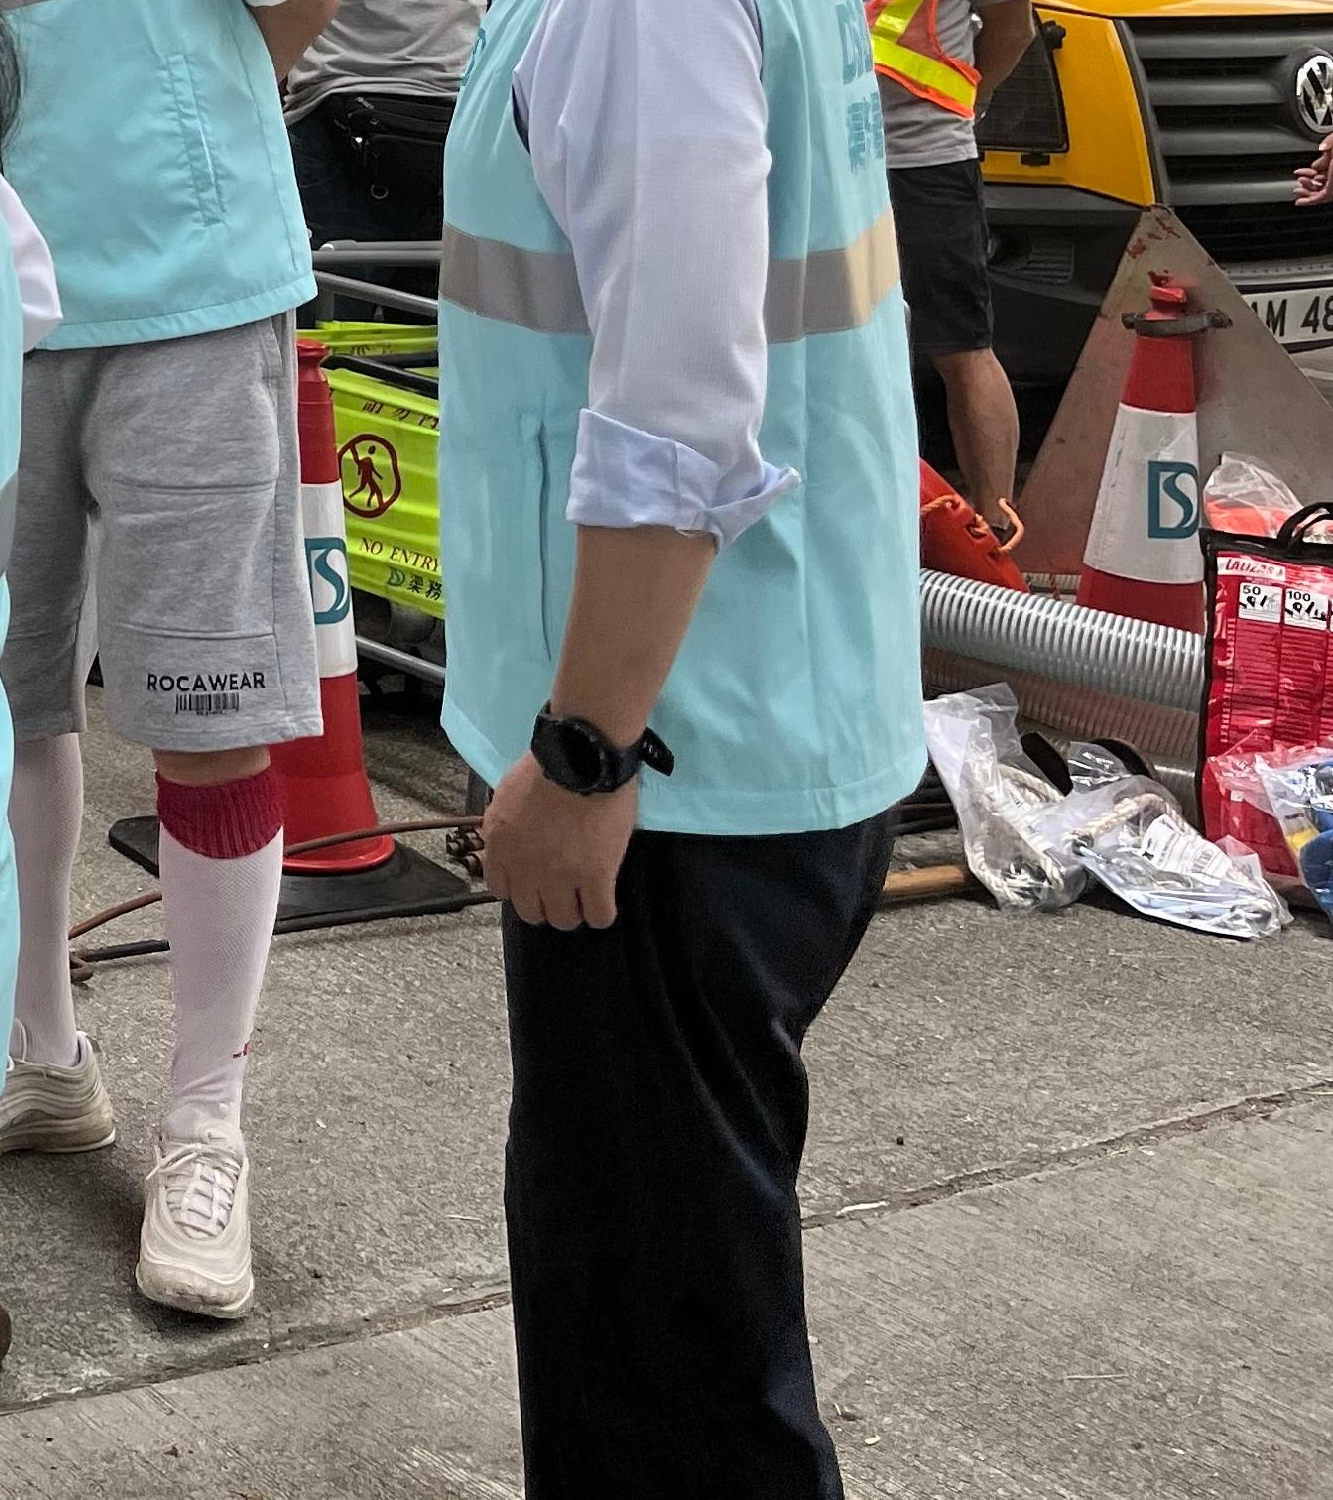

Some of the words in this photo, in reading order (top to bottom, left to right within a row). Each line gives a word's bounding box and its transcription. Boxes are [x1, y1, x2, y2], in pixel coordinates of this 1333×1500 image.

[359, 536, 383, 556] NO
[1242, 584, 1261, 596] 50
[1287, 590, 1311, 603] 100
[146, 671, 266, 692] ROCAWEAR
